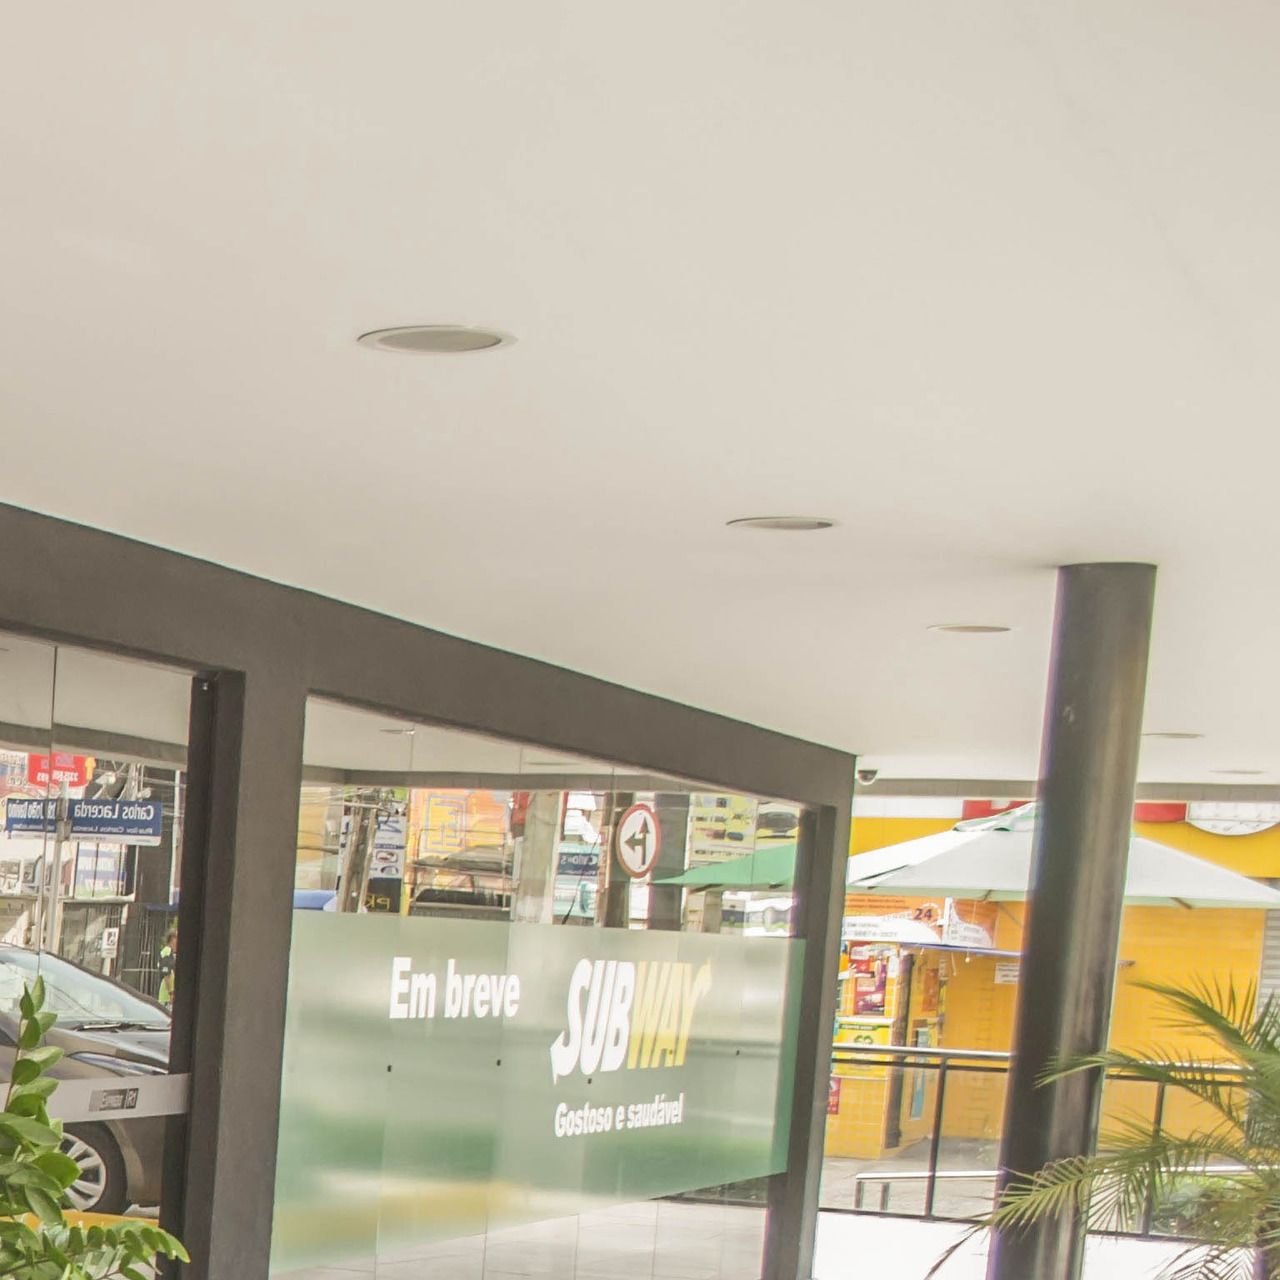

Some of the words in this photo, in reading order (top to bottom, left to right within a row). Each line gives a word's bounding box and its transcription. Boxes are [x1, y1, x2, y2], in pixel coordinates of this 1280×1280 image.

[913, 908, 933, 920] 24
[389, 956, 437, 1019] Em
[443, 958, 520, 1019] breve
[550, 957, 713, 1086] SUBWAY
[555, 1101, 613, 1138] Gostoso
[615, 1110, 625, 1128] e
[626, 1093, 685, 1130] saudável
